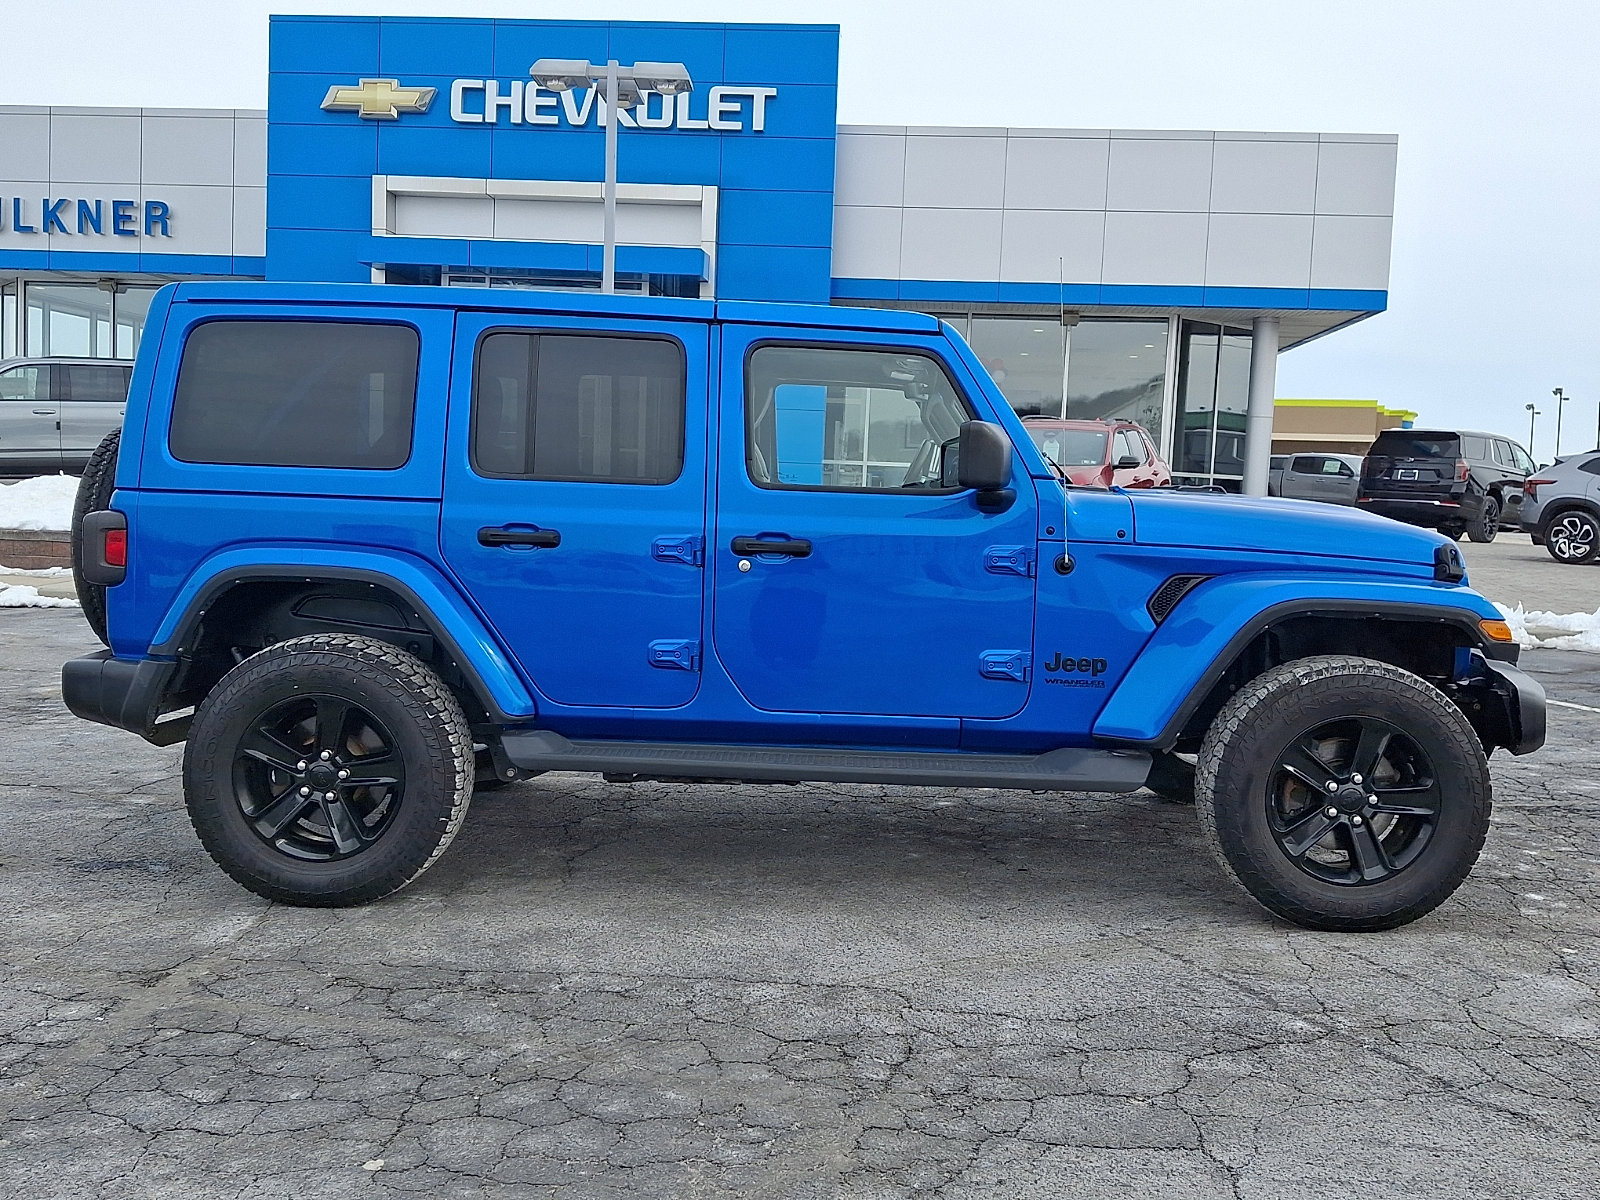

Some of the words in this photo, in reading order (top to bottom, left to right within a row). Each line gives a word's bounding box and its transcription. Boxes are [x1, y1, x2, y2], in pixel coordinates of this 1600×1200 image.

[0, 197, 174, 237] LKNER
[1045, 651, 1107, 677] Jeep
[1045, 678, 1105, 686] WRANGLER
